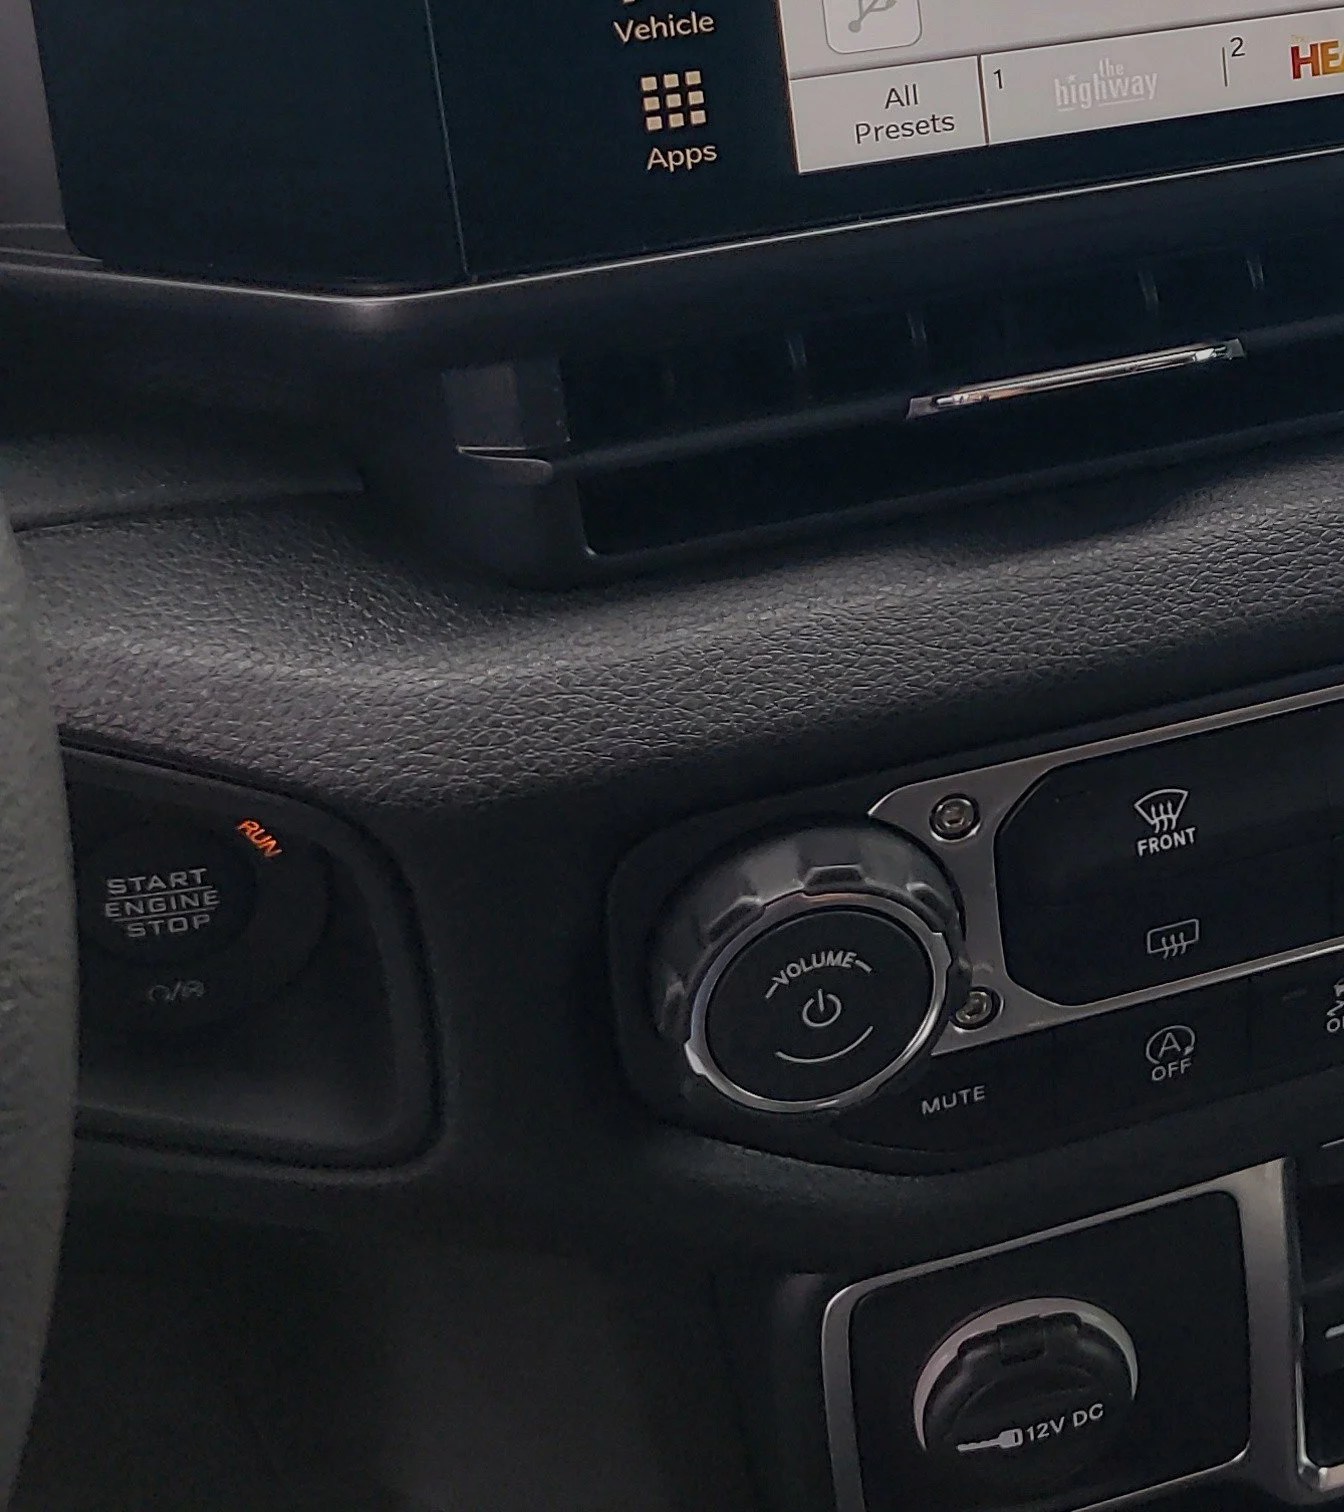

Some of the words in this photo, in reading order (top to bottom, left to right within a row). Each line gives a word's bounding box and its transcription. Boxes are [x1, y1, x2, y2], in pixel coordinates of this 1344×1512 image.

[613, 10, 715, 45] Vehicle
[1230, 37, 1246, 58] 2
[993, 68, 1005, 90] 1
[1054, 72, 1159, 110] highway
[884, 83, 919, 109] All
[854, 112, 955, 145] Presets
[646, 143, 718, 171] Apps
[237, 818, 283, 858] RUN
[1136, 826, 1197, 857] FRONT
[106, 868, 208, 895] START
[104, 889, 221, 919] ENGINE
[127, 913, 211, 938] STOP
[773, 950, 858, 989] VOLUME
[1151, 1058, 1192, 1082] OFF
[920, 1085, 987, 1116] MUTE
[1025, 1416, 1065, 1442] 12V
[1072, 1402, 1104, 1428] DC
